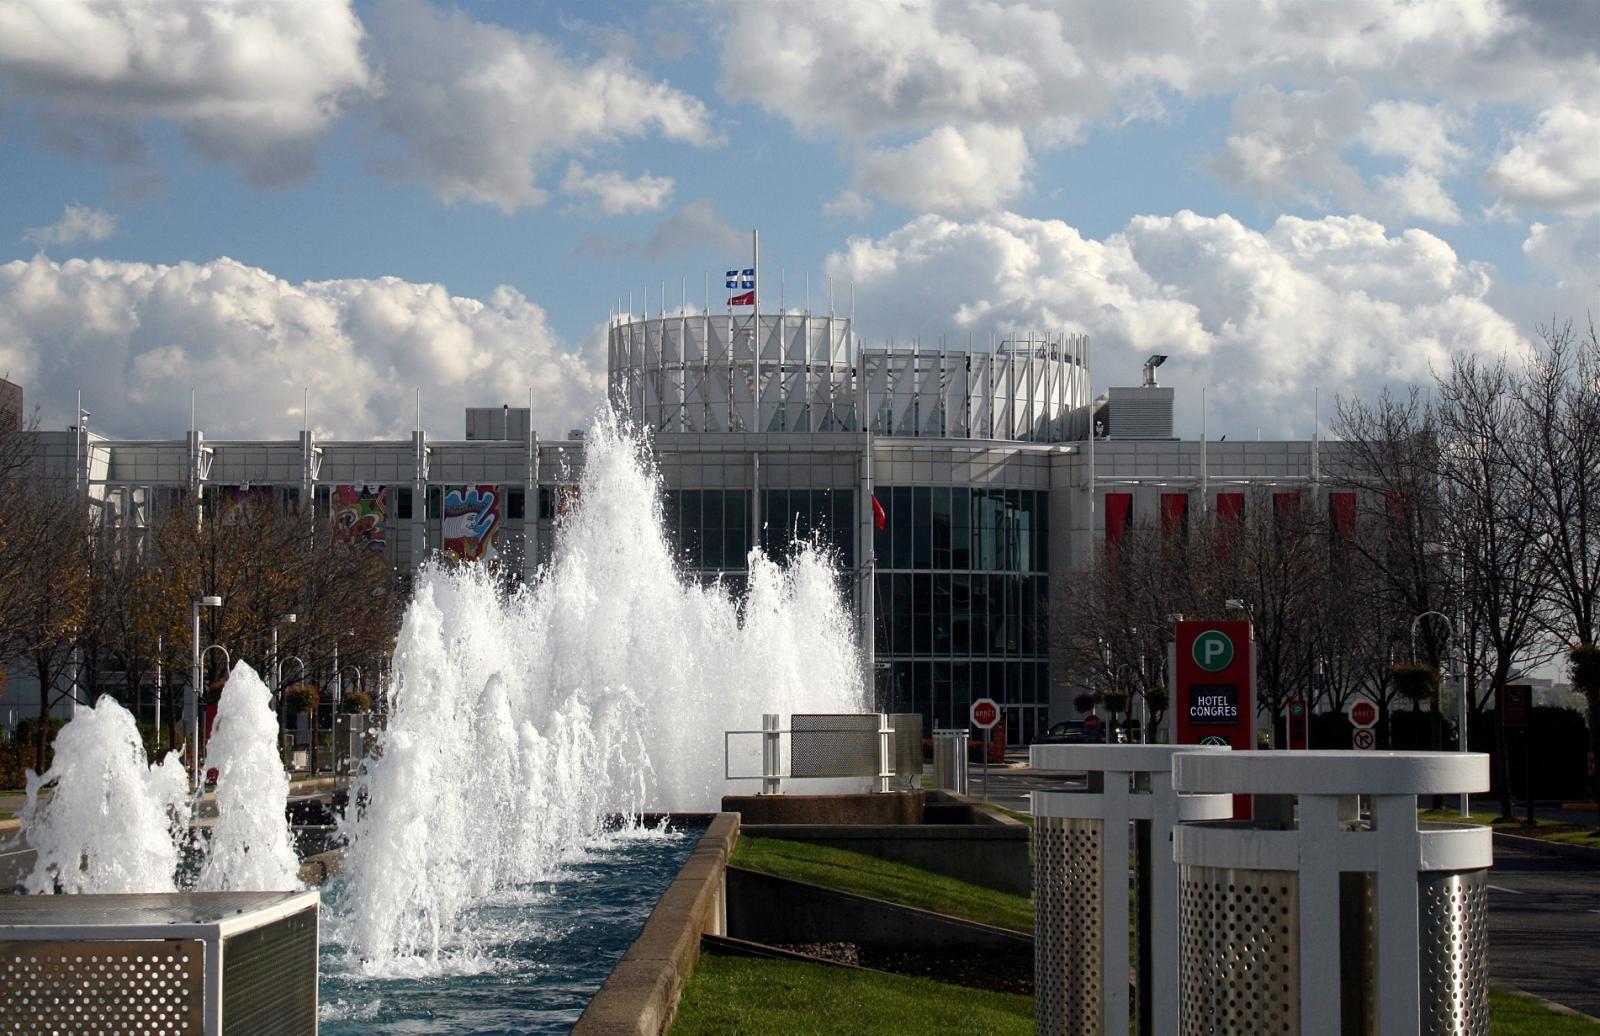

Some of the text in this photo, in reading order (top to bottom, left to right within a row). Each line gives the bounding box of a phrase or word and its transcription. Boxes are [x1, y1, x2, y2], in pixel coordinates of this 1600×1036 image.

[1204, 639, 1225, 665] P
[1197, 695, 1229, 706] HOTEL
[1190, 706, 1237, 717] CONGRES
